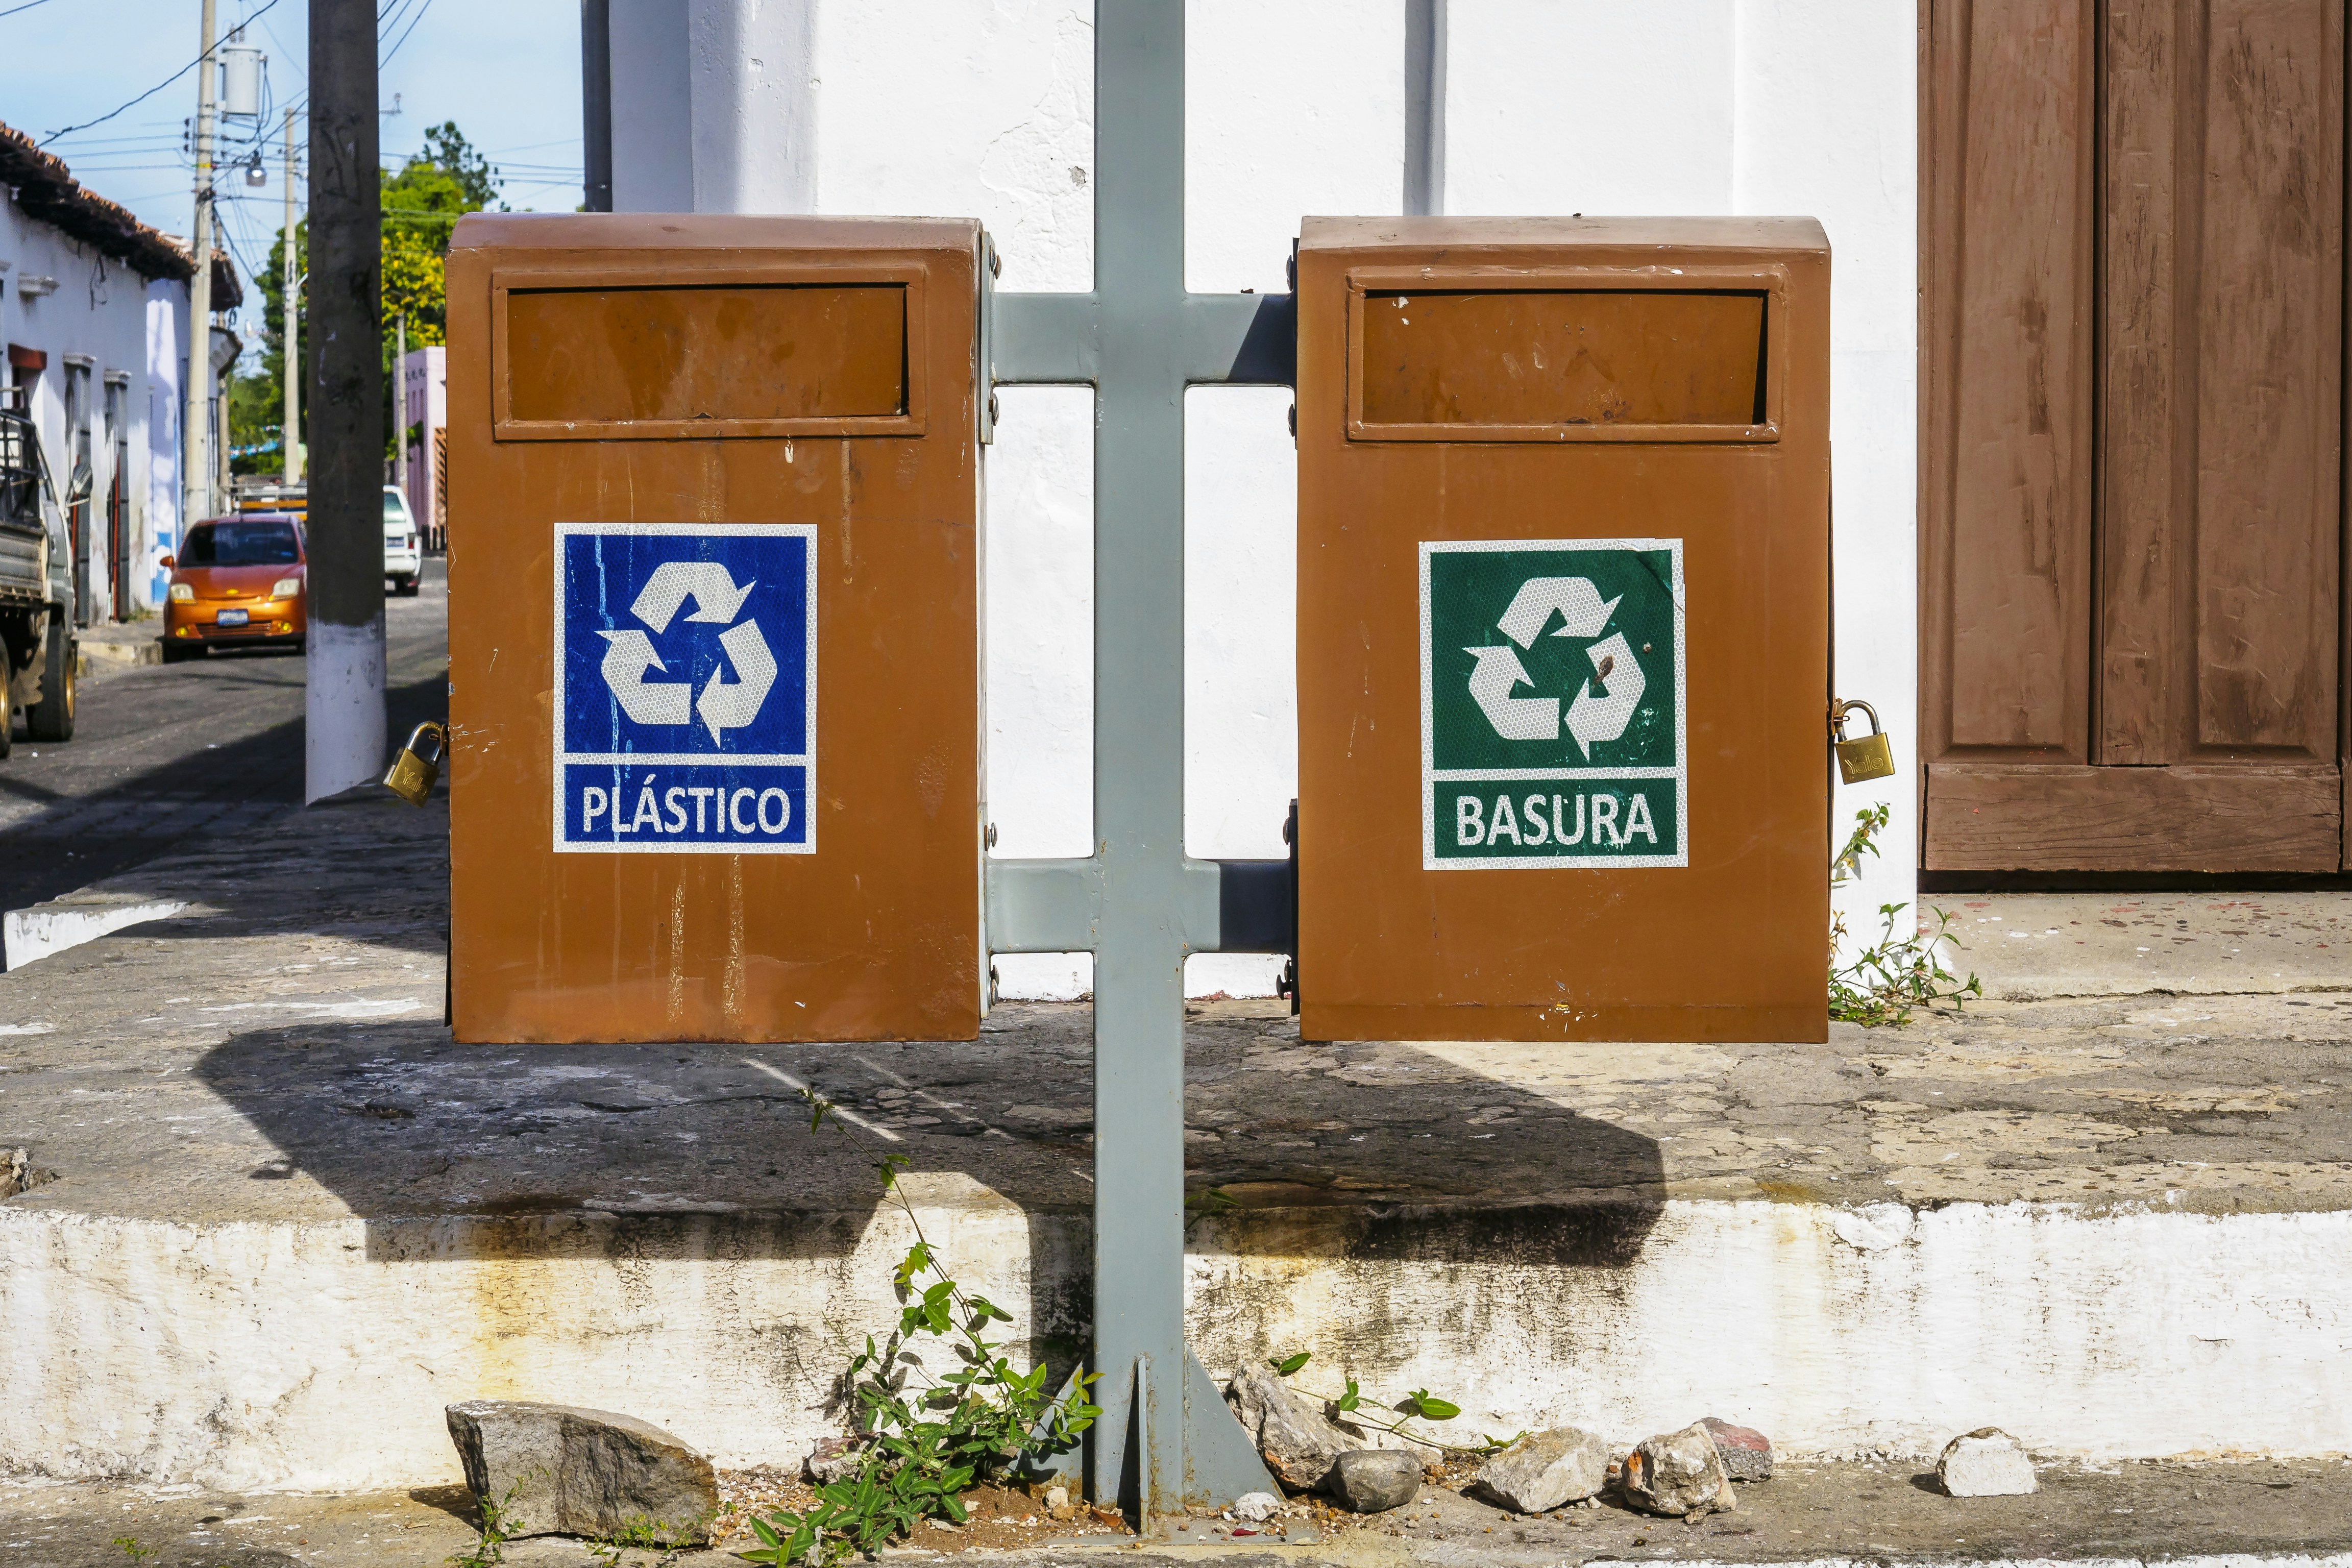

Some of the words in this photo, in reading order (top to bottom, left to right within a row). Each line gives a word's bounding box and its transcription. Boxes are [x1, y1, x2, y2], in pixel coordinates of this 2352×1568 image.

[402, 767, 427, 796] Yale
[1844, 754, 1883, 774] Yale
[583, 774, 790, 834] PLÁSTICO
[1457, 793, 1658, 846] BASURA
